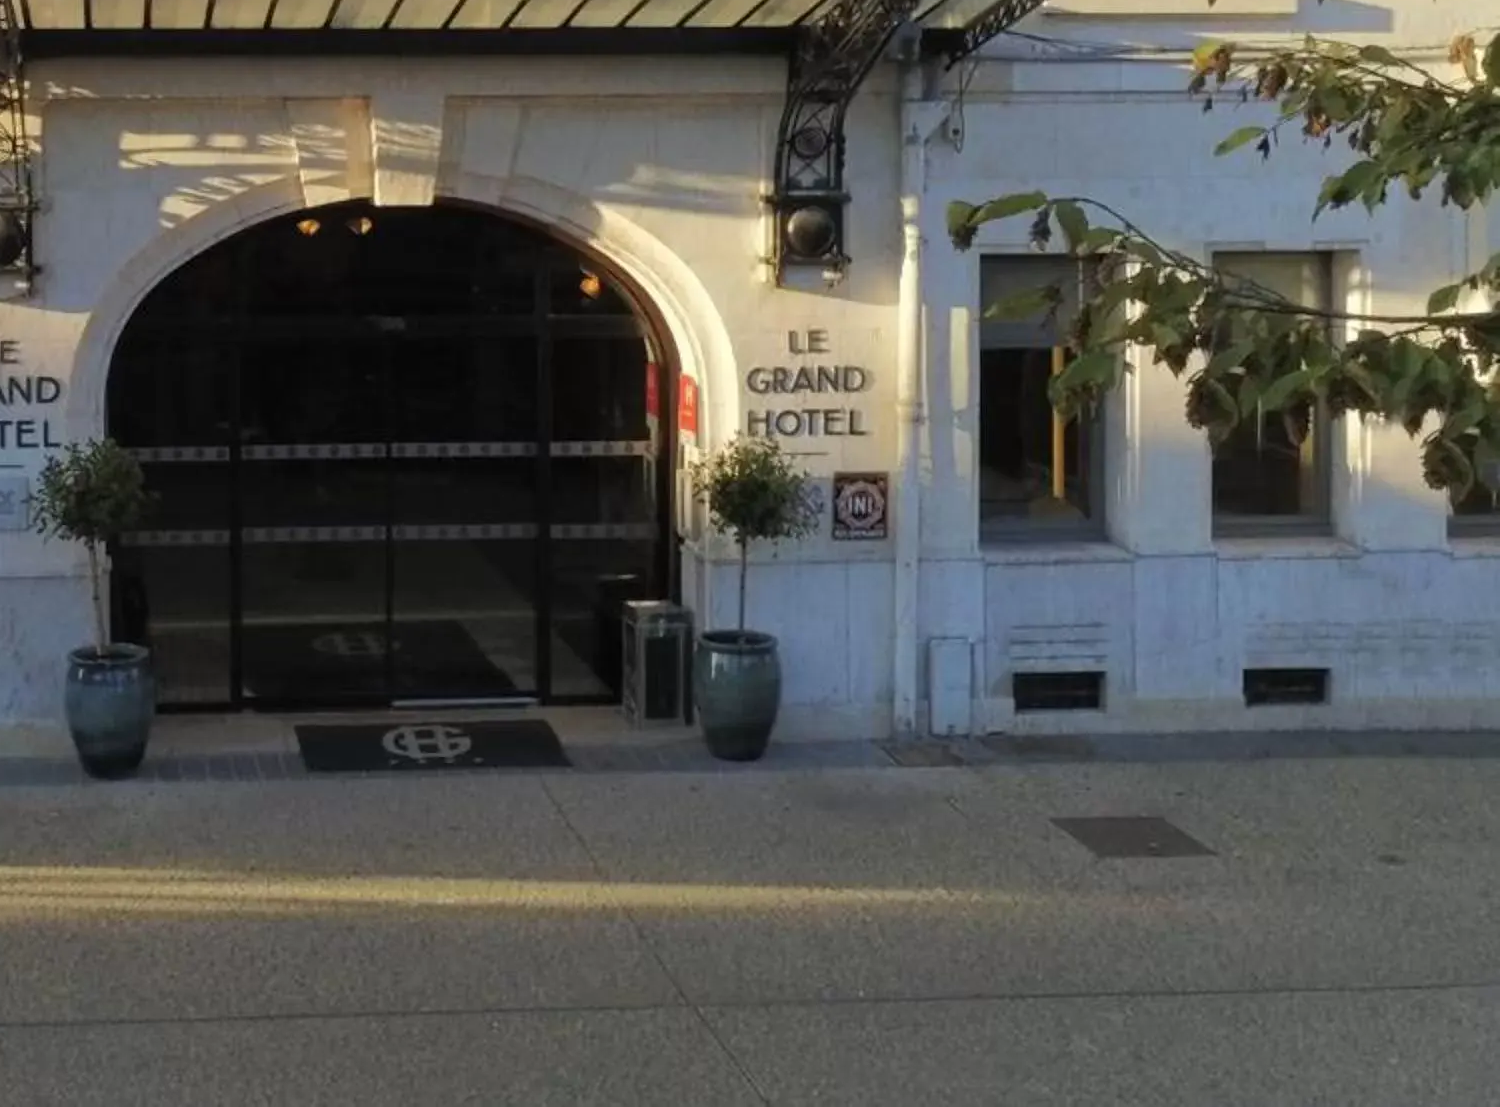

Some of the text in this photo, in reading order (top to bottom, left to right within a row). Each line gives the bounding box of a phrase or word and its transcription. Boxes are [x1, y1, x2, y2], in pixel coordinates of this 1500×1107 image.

[787, 329, 829, 354] LE
[746, 366, 869, 394] GRAND
[747, 409, 870, 437] HOTEL
